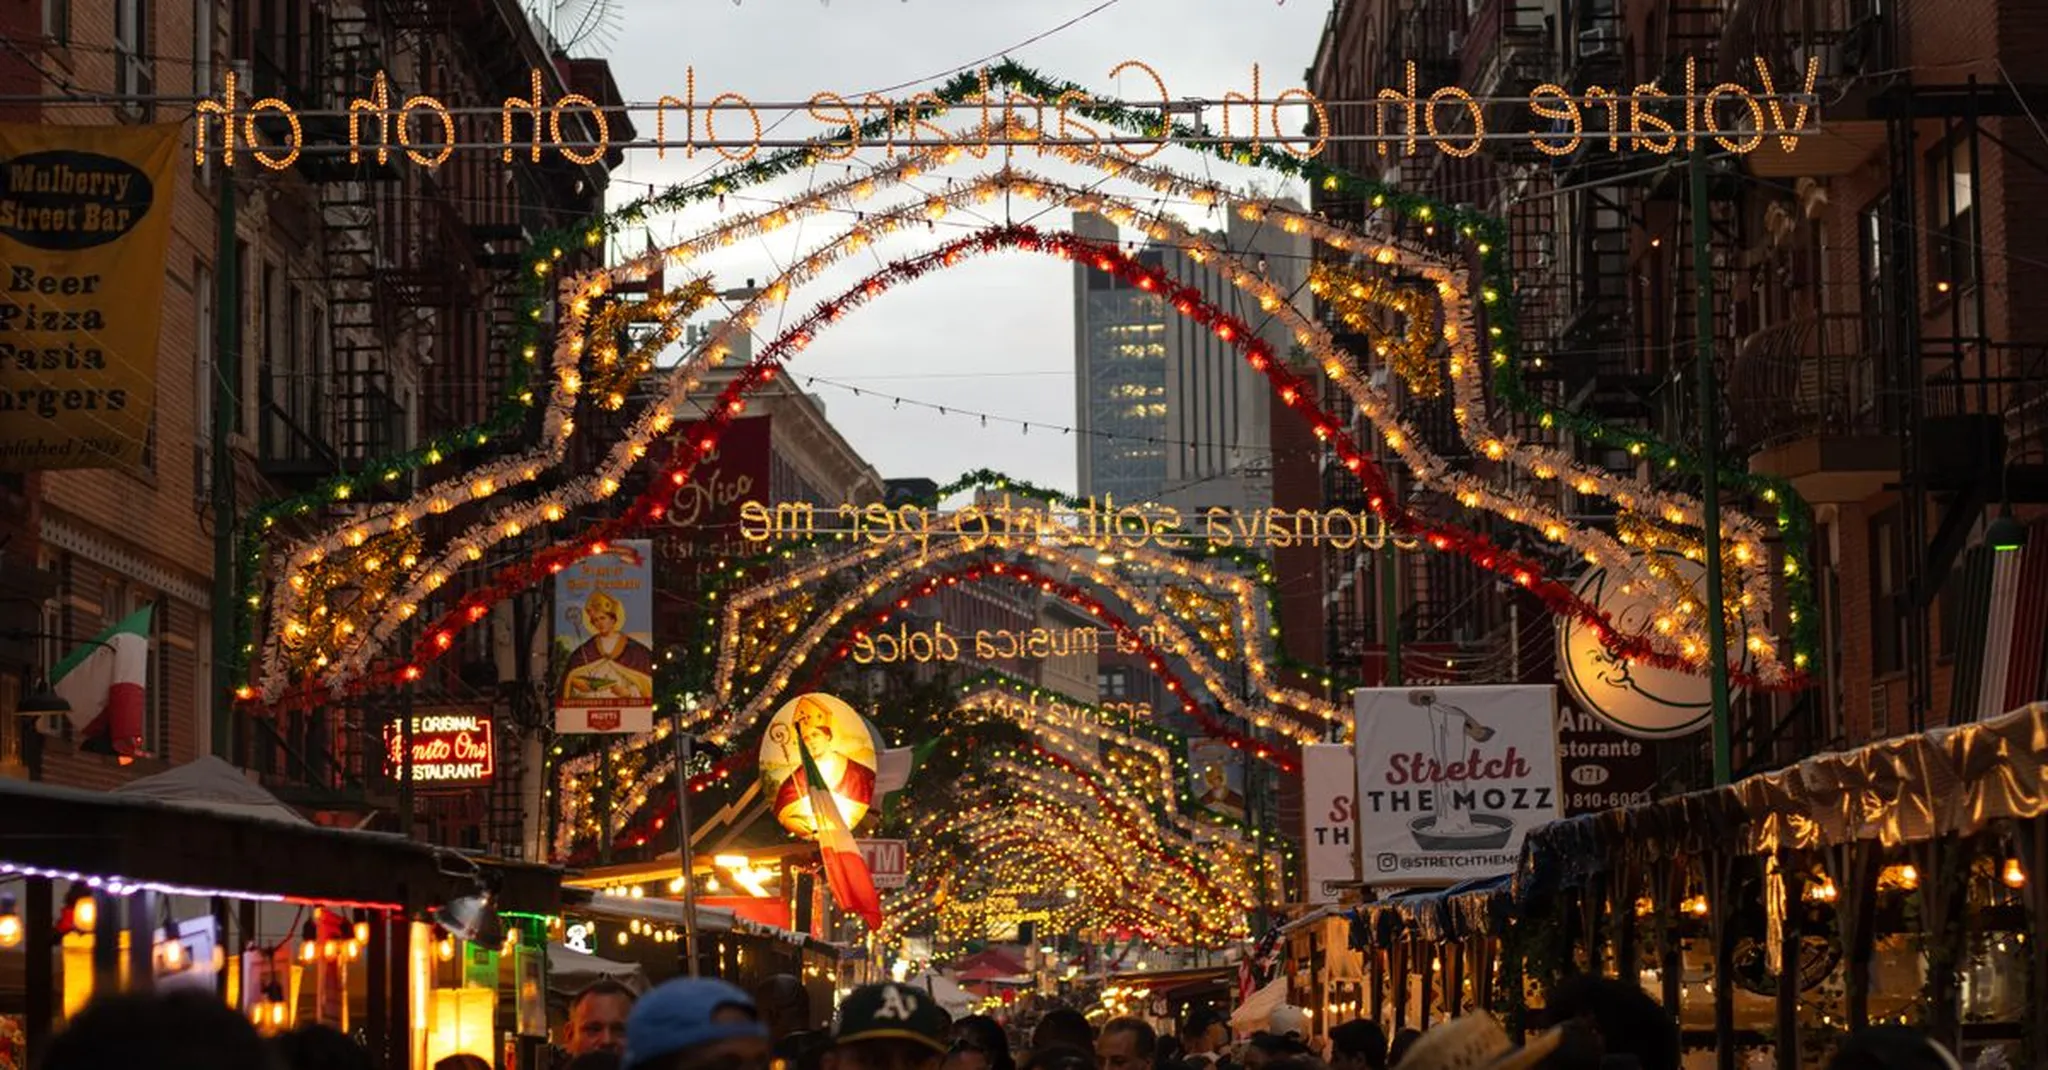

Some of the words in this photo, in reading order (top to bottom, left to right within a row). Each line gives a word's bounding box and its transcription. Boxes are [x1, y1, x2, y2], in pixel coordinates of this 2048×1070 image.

[10, 164, 133, 201] Mulberry
[0, 200, 76, 231] Street
[82, 202, 131, 232] Bar
[8, 265, 100, 296] Beer
[0, 302, 106, 331] Pizza
[0, 342, 106, 370] Pasta
[667, 469, 754, 527] Nico
[394, 717, 420, 734] TE
[422, 716, 481, 733] ORIGINAL
[391, 734, 450, 763] nito
[394, 763, 483, 781] STAURANT
[1385, 746, 1532, 786] Stretch
[1367, 789, 1434, 813] THE
[1453, 786, 1554, 812] MOZZ
